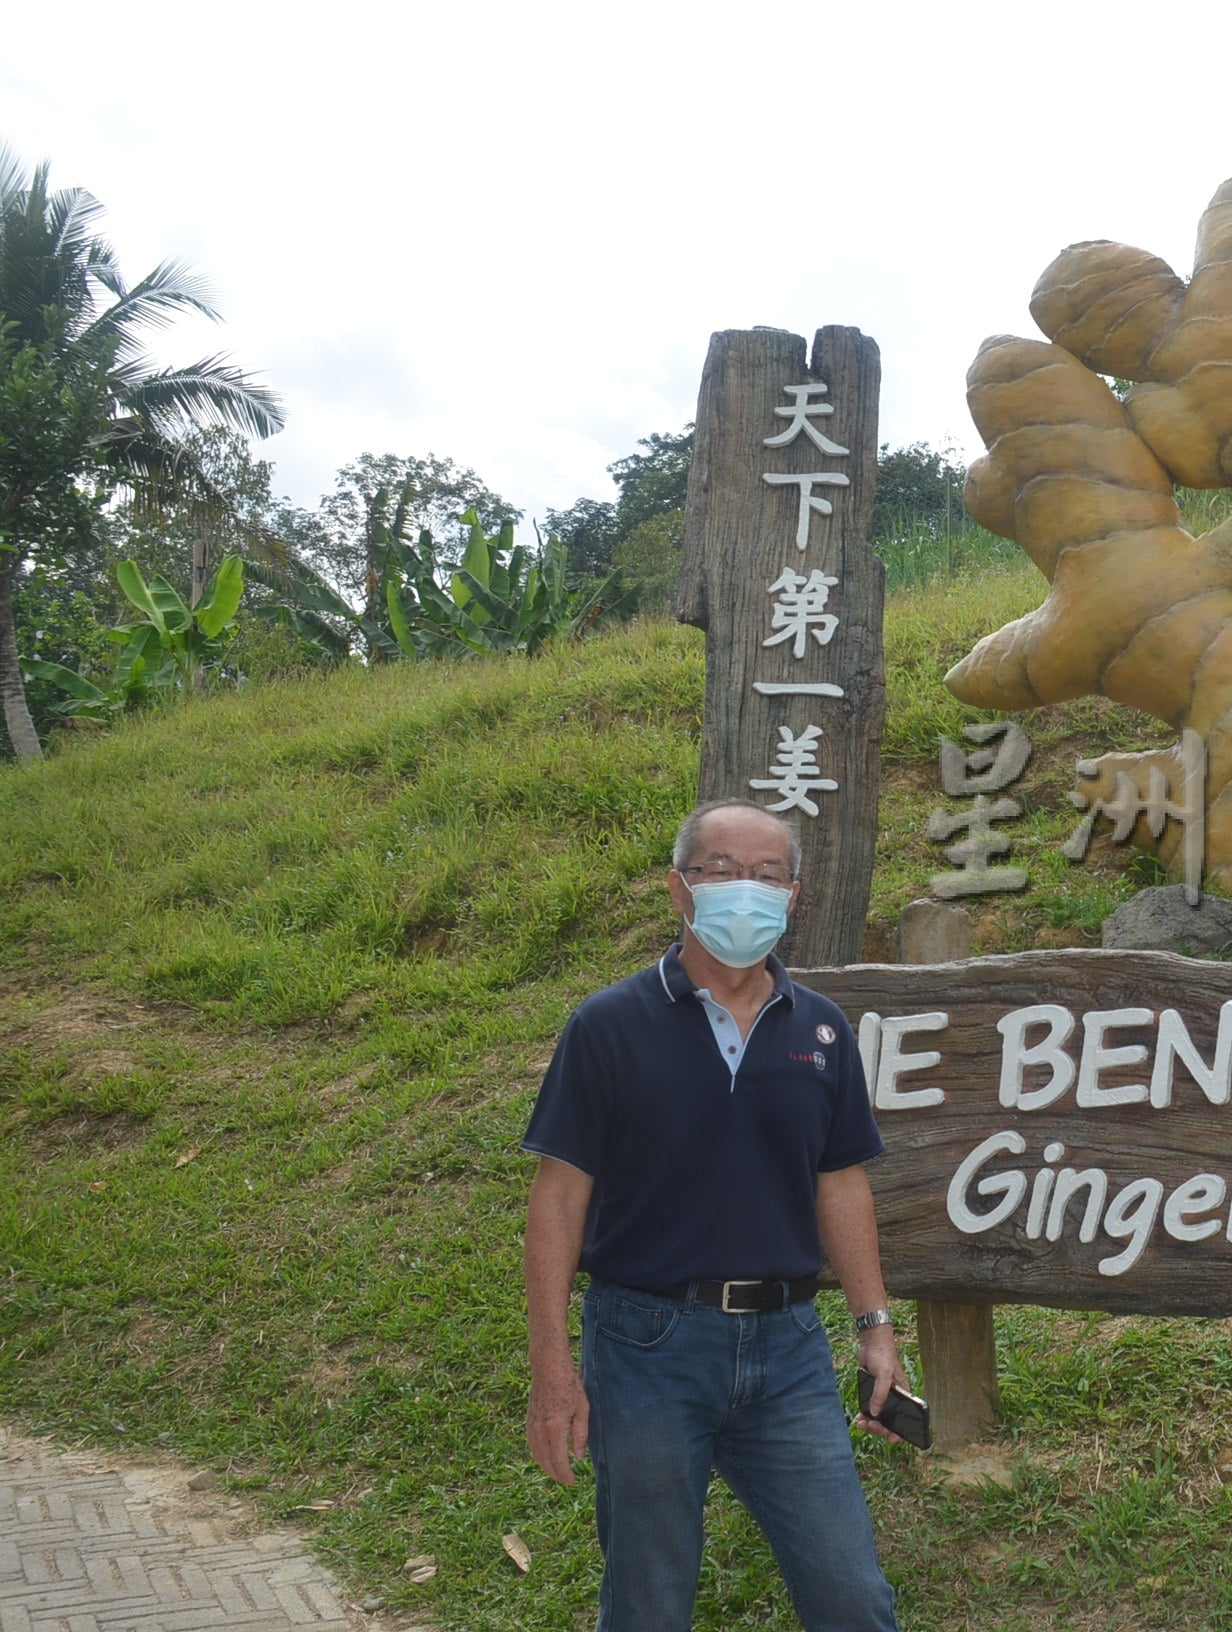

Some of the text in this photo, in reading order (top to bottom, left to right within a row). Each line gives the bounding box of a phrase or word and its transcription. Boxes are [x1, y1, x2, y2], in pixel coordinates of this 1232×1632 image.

[749, 382, 851, 818] 天下第一姜
